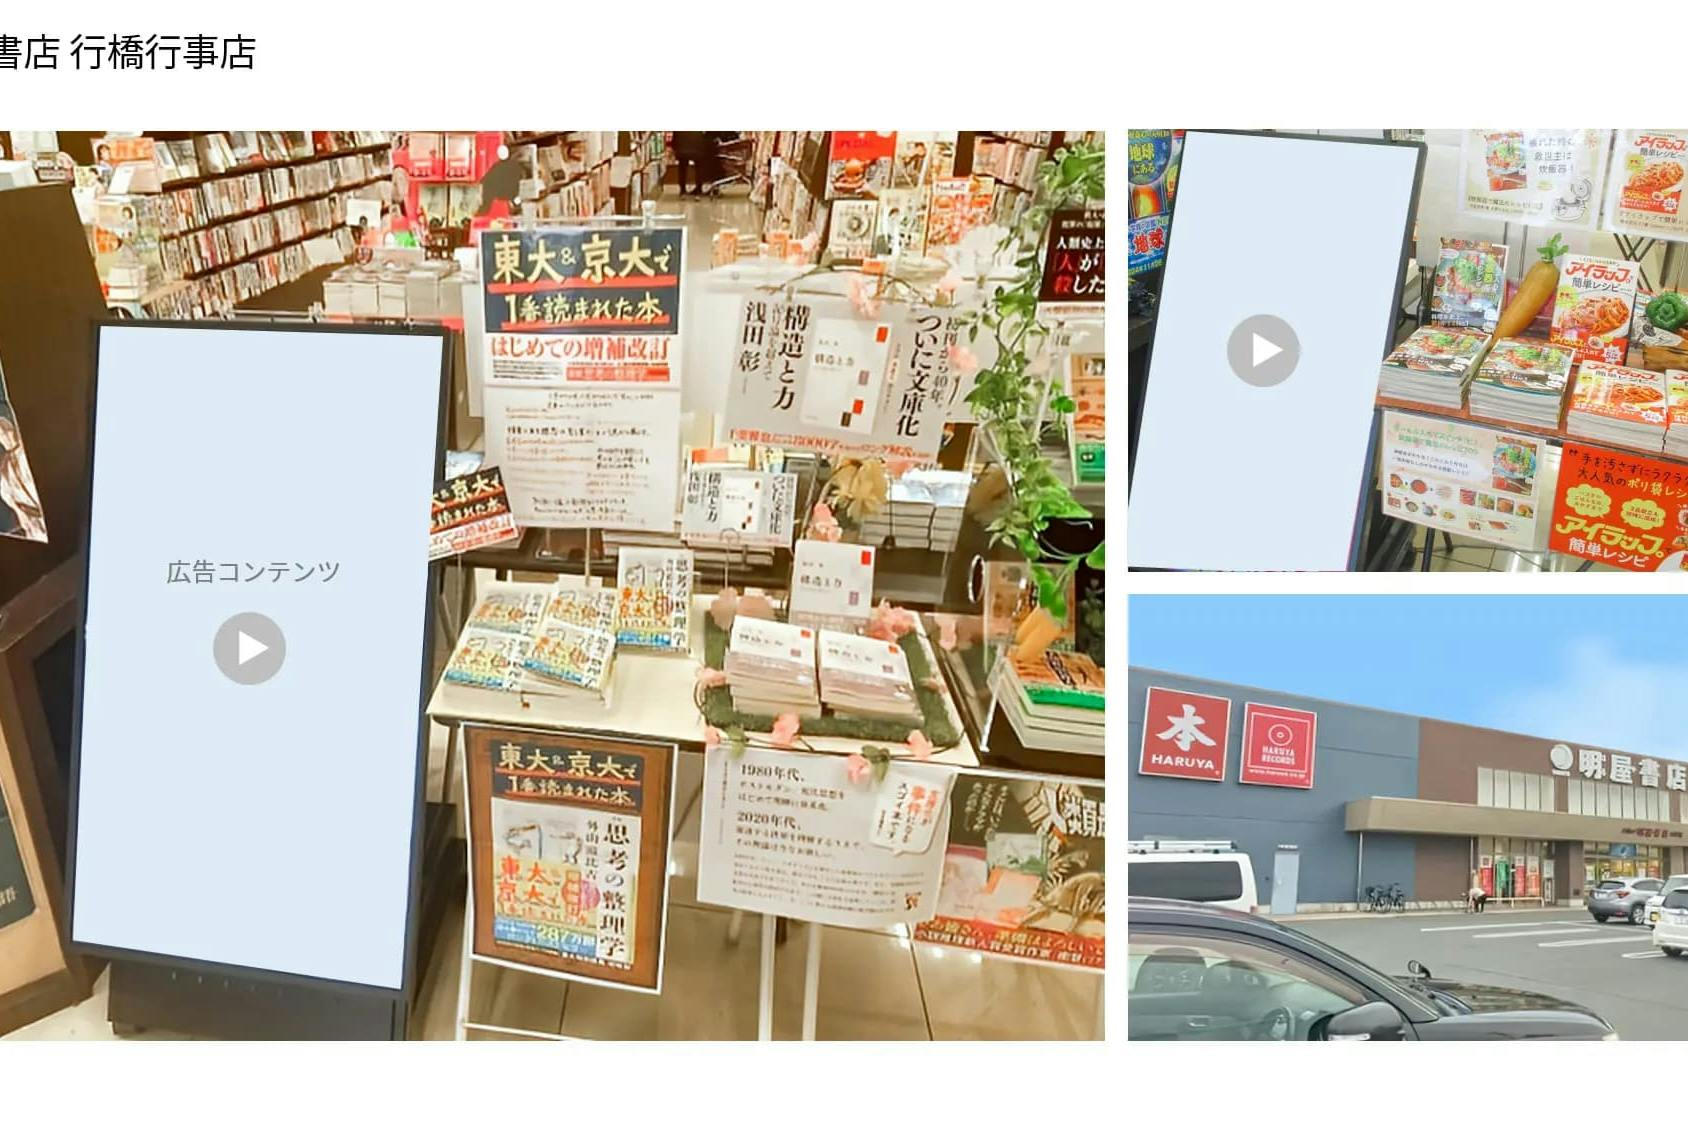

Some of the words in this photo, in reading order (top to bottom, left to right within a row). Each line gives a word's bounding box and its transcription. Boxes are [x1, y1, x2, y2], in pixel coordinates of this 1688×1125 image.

[493, 233, 673, 285] 東大&京大で
[505, 291, 663, 324] 1番読まれた本
[491, 336, 671, 361] はじめての増補改訂
[771, 304, 811, 411] 構造と力
[896, 314, 942, 437] ついに文庫化
[1568, 536, 1650, 568] 簡単レシピ
[1156, 703, 1217, 752] 本
[1151, 753, 1214, 770] HARUYA
[1262, 745, 1295, 757] HARUYA
[741, 763, 804, 782] 1980年代、
[1579, 748, 1688, 791] 明屋書店
[508, 775, 632, 806] 1番読まれた本
[736, 811, 801, 831] 2020年代、
[600, 821, 631, 957] 思考の整理学
